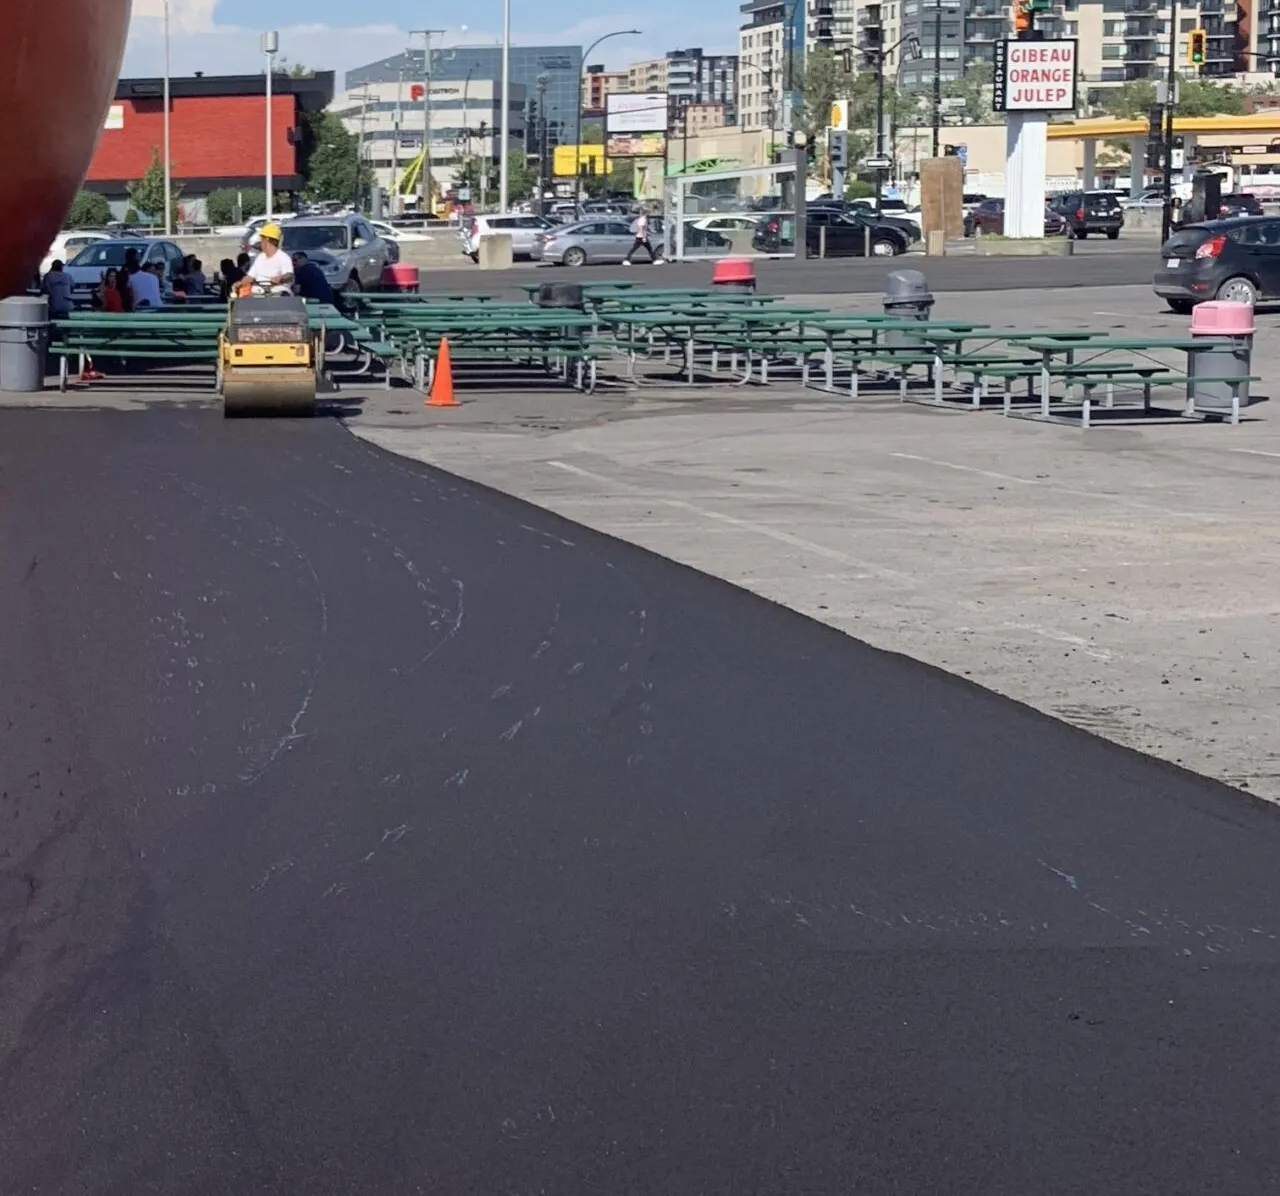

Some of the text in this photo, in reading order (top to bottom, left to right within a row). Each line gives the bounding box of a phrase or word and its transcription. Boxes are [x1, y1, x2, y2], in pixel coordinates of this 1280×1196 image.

[1011, 49, 1071, 62] GIBEAU
[995, 41, 1004, 110] RESTAURANT
[1010, 69, 1071, 83] ORANGE
[1013, 89, 1067, 102] JULEP
